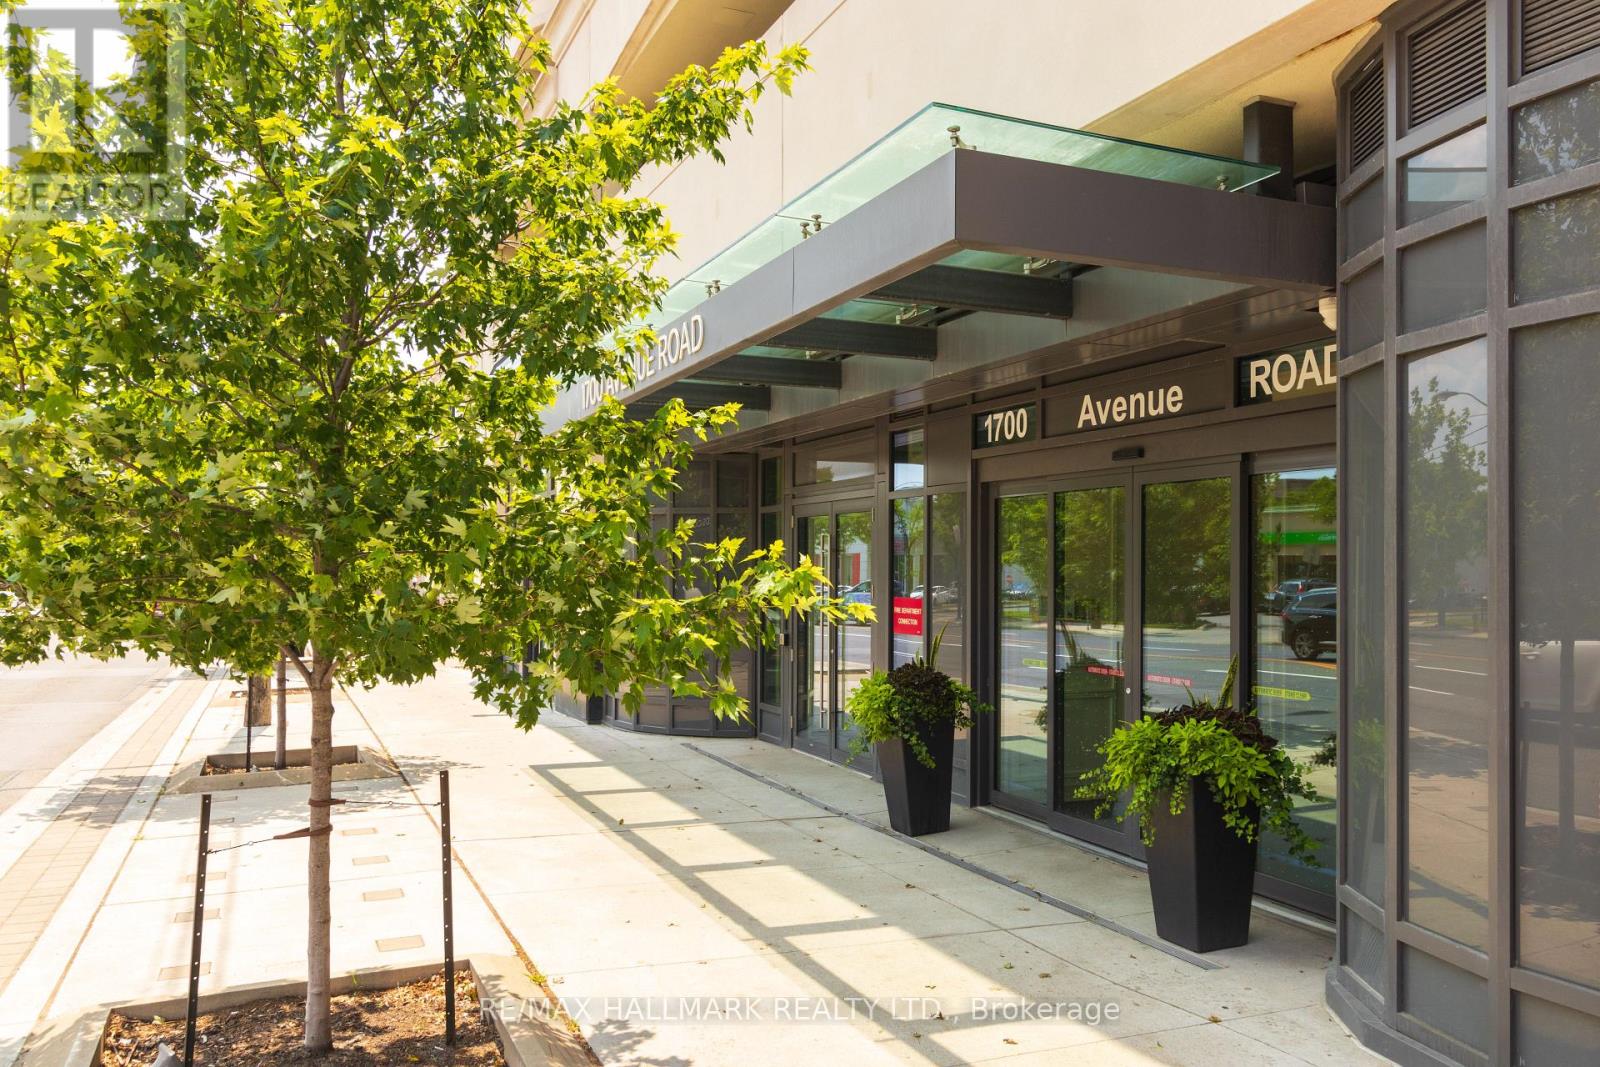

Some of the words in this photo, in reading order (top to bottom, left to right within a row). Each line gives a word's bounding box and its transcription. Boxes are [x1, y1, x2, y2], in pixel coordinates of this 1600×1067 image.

[658, 314, 705, 370] ROAD
[983, 408, 1028, 443] 1700
[1077, 385, 1183, 429] Avenue
